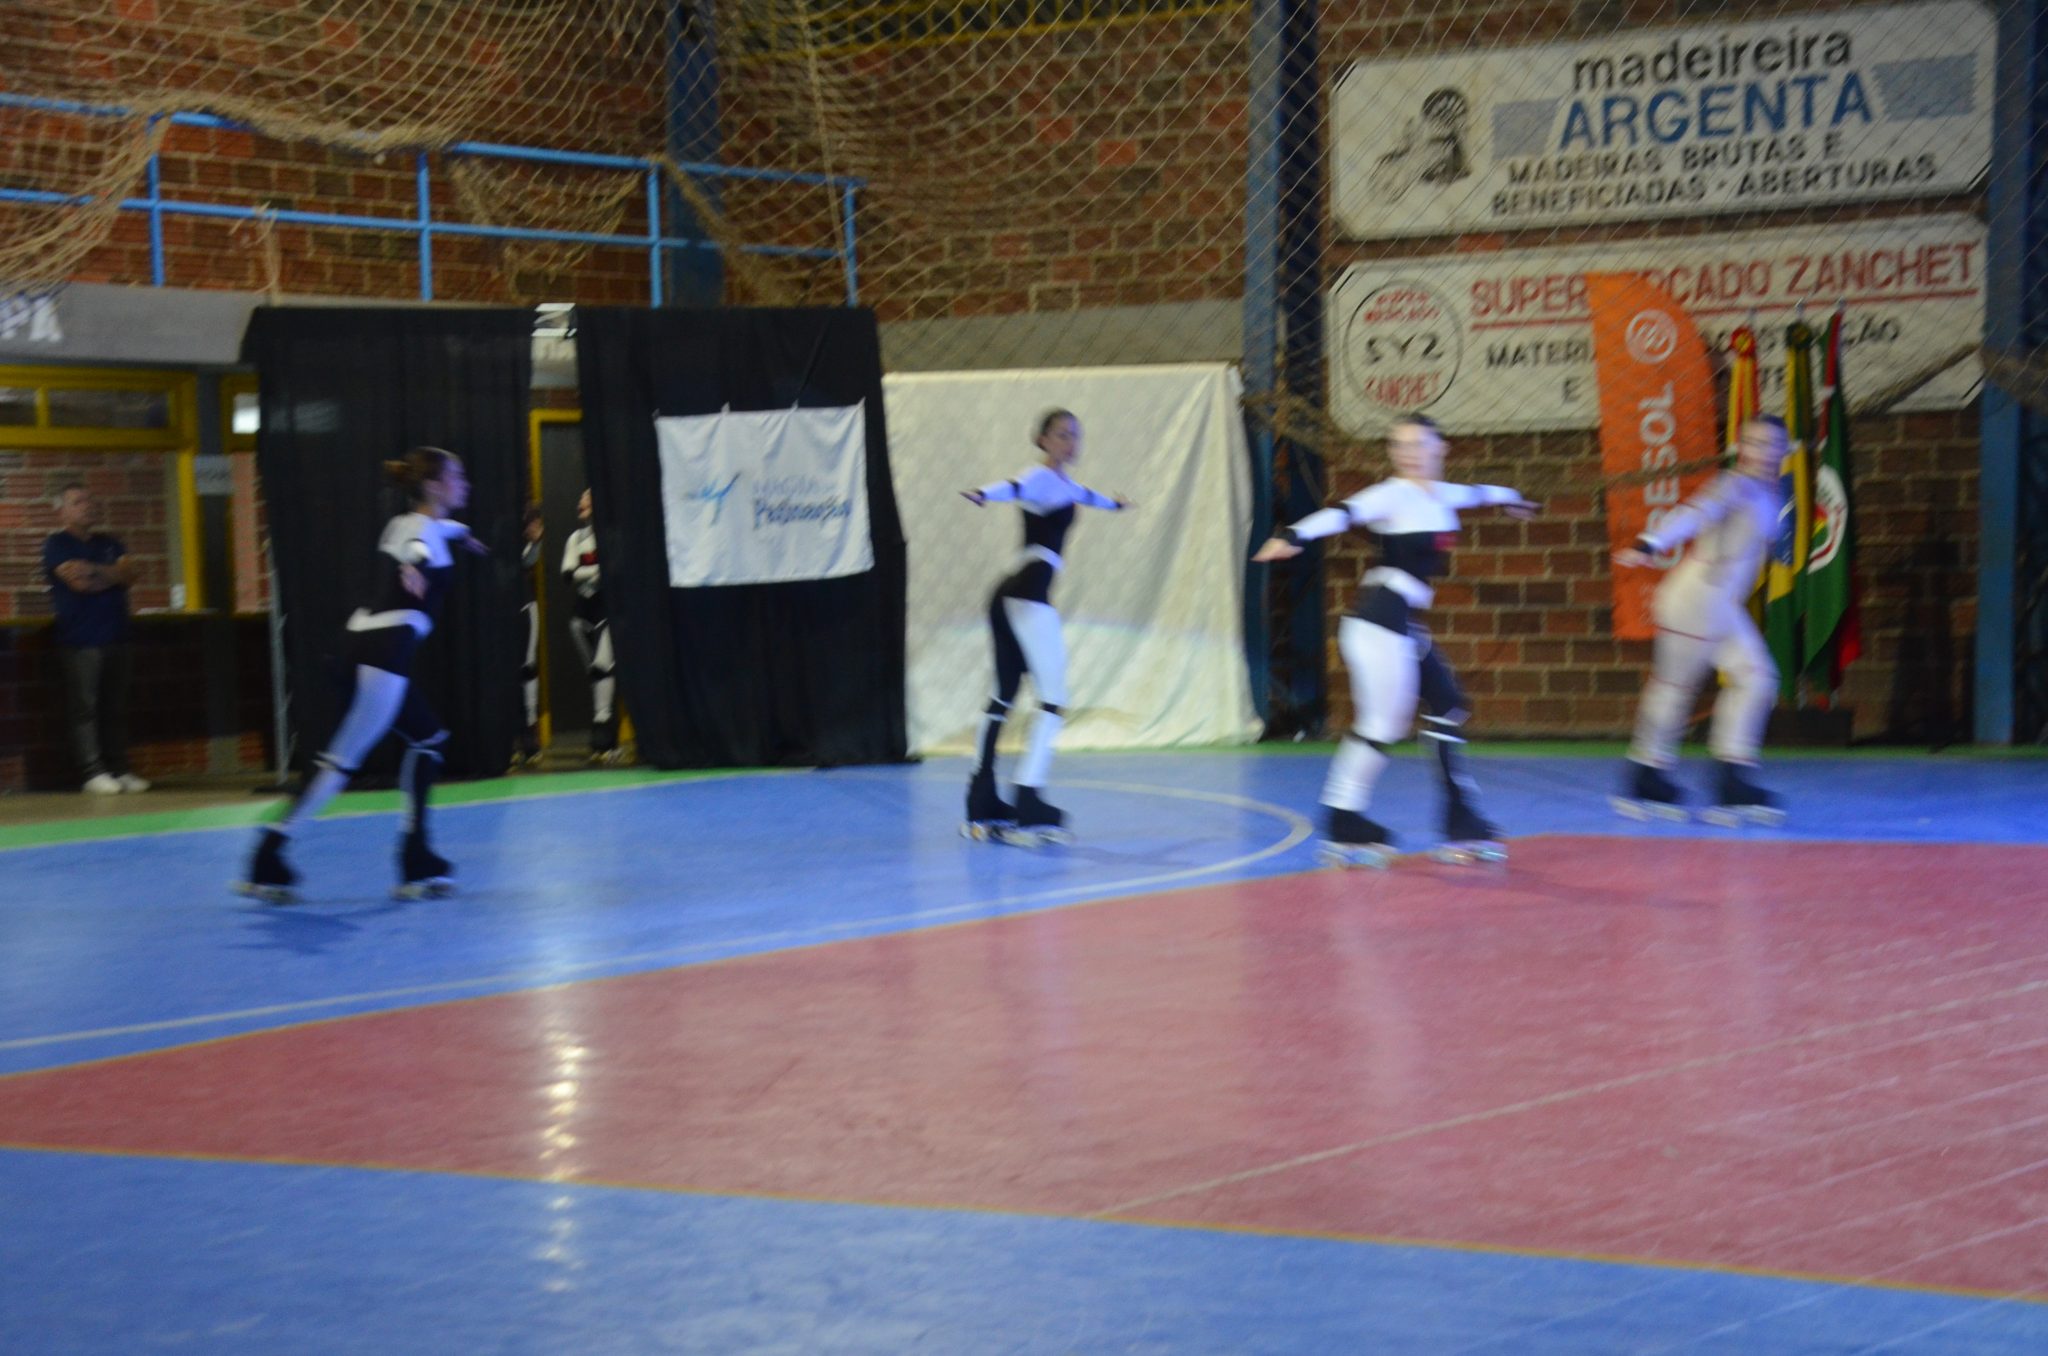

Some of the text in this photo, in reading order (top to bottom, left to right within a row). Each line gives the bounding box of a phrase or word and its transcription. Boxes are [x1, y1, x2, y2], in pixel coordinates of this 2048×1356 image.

[1573, 26, 1852, 91] madeireira
[1559, 70, 1874, 150] ARGENTA
[1491, 152, 1937, 218] BENEFICIADAS ABERTURAS
[1508, 130, 1843, 185] MADEIRAS BRUTAS E
[1784, 239, 1981, 296] ZANCHET
